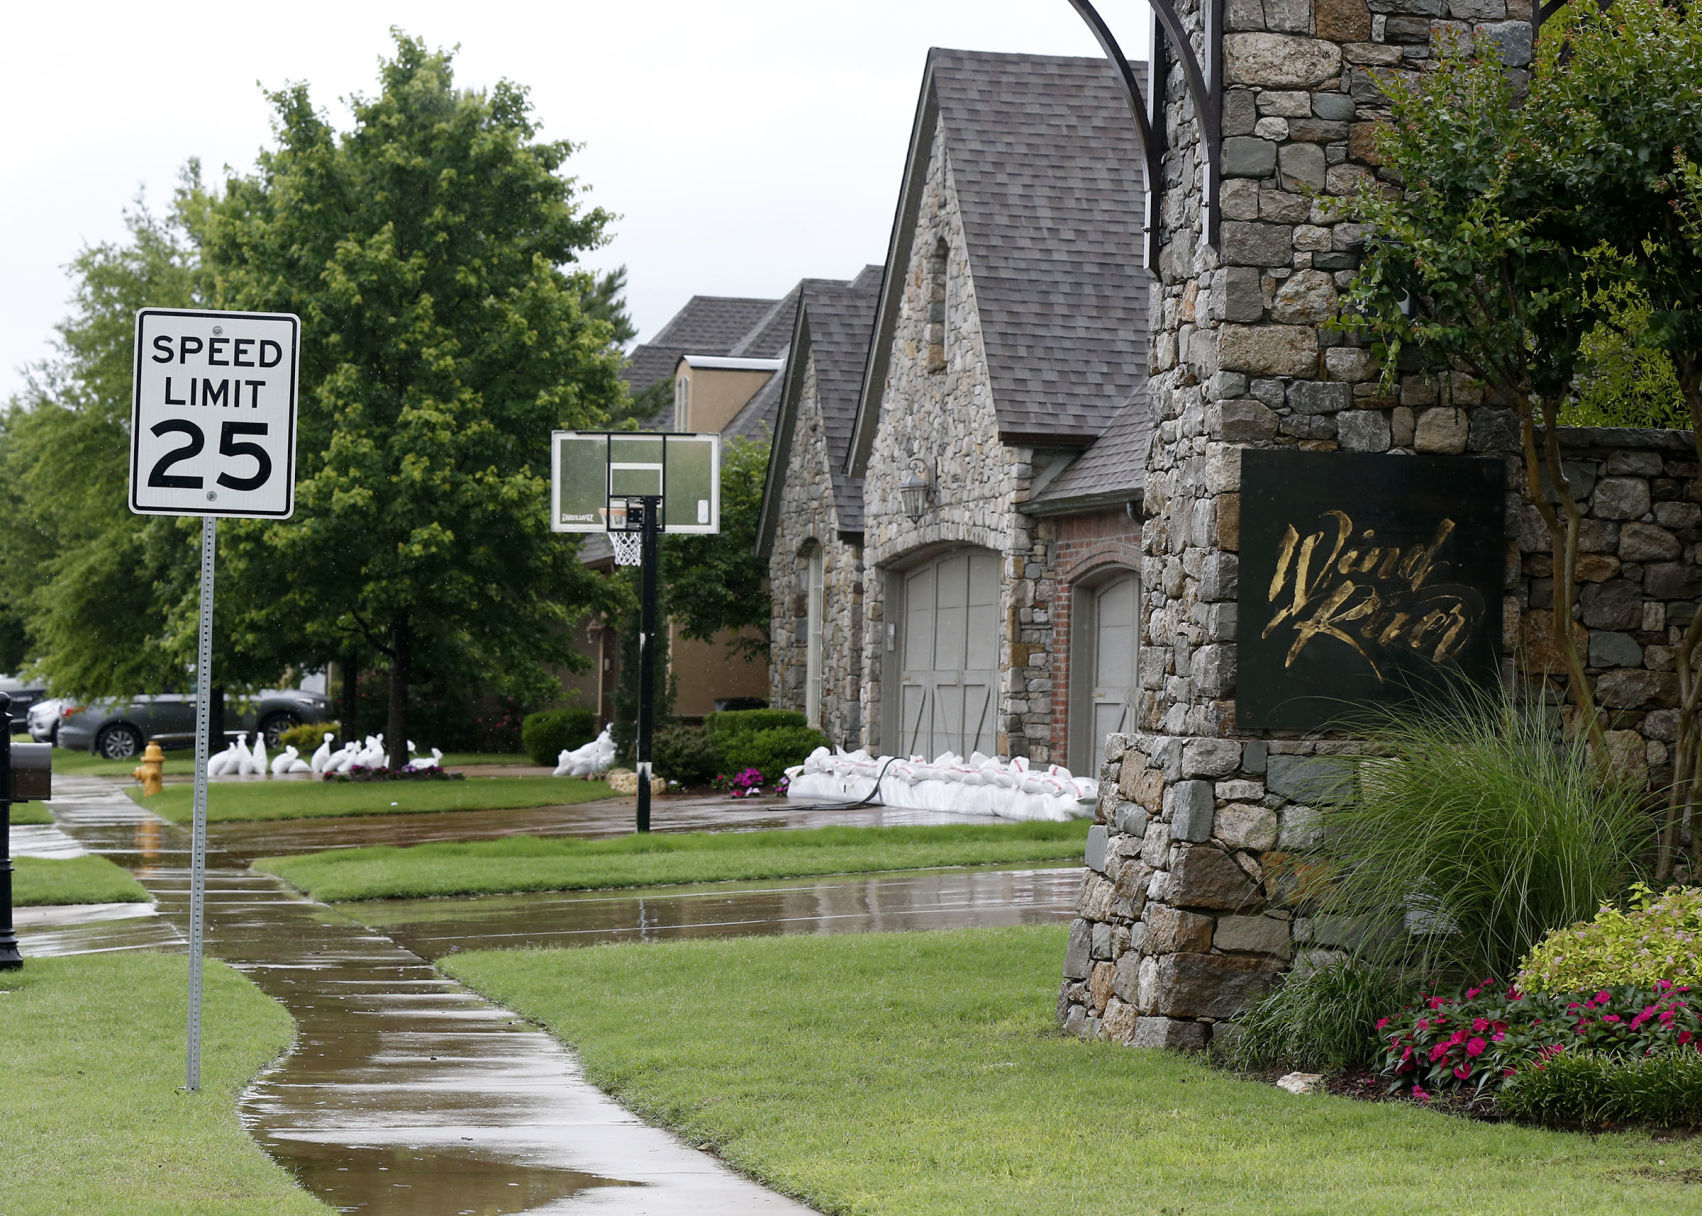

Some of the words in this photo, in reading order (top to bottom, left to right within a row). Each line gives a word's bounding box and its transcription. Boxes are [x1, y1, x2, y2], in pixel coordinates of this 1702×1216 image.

[152, 335, 283, 368] SPEED
[165, 377, 266, 408] LIMIT
[148, 419, 272, 491] 25
[1268, 509, 1456, 616] Wind
[1262, 580, 1486, 684] River
